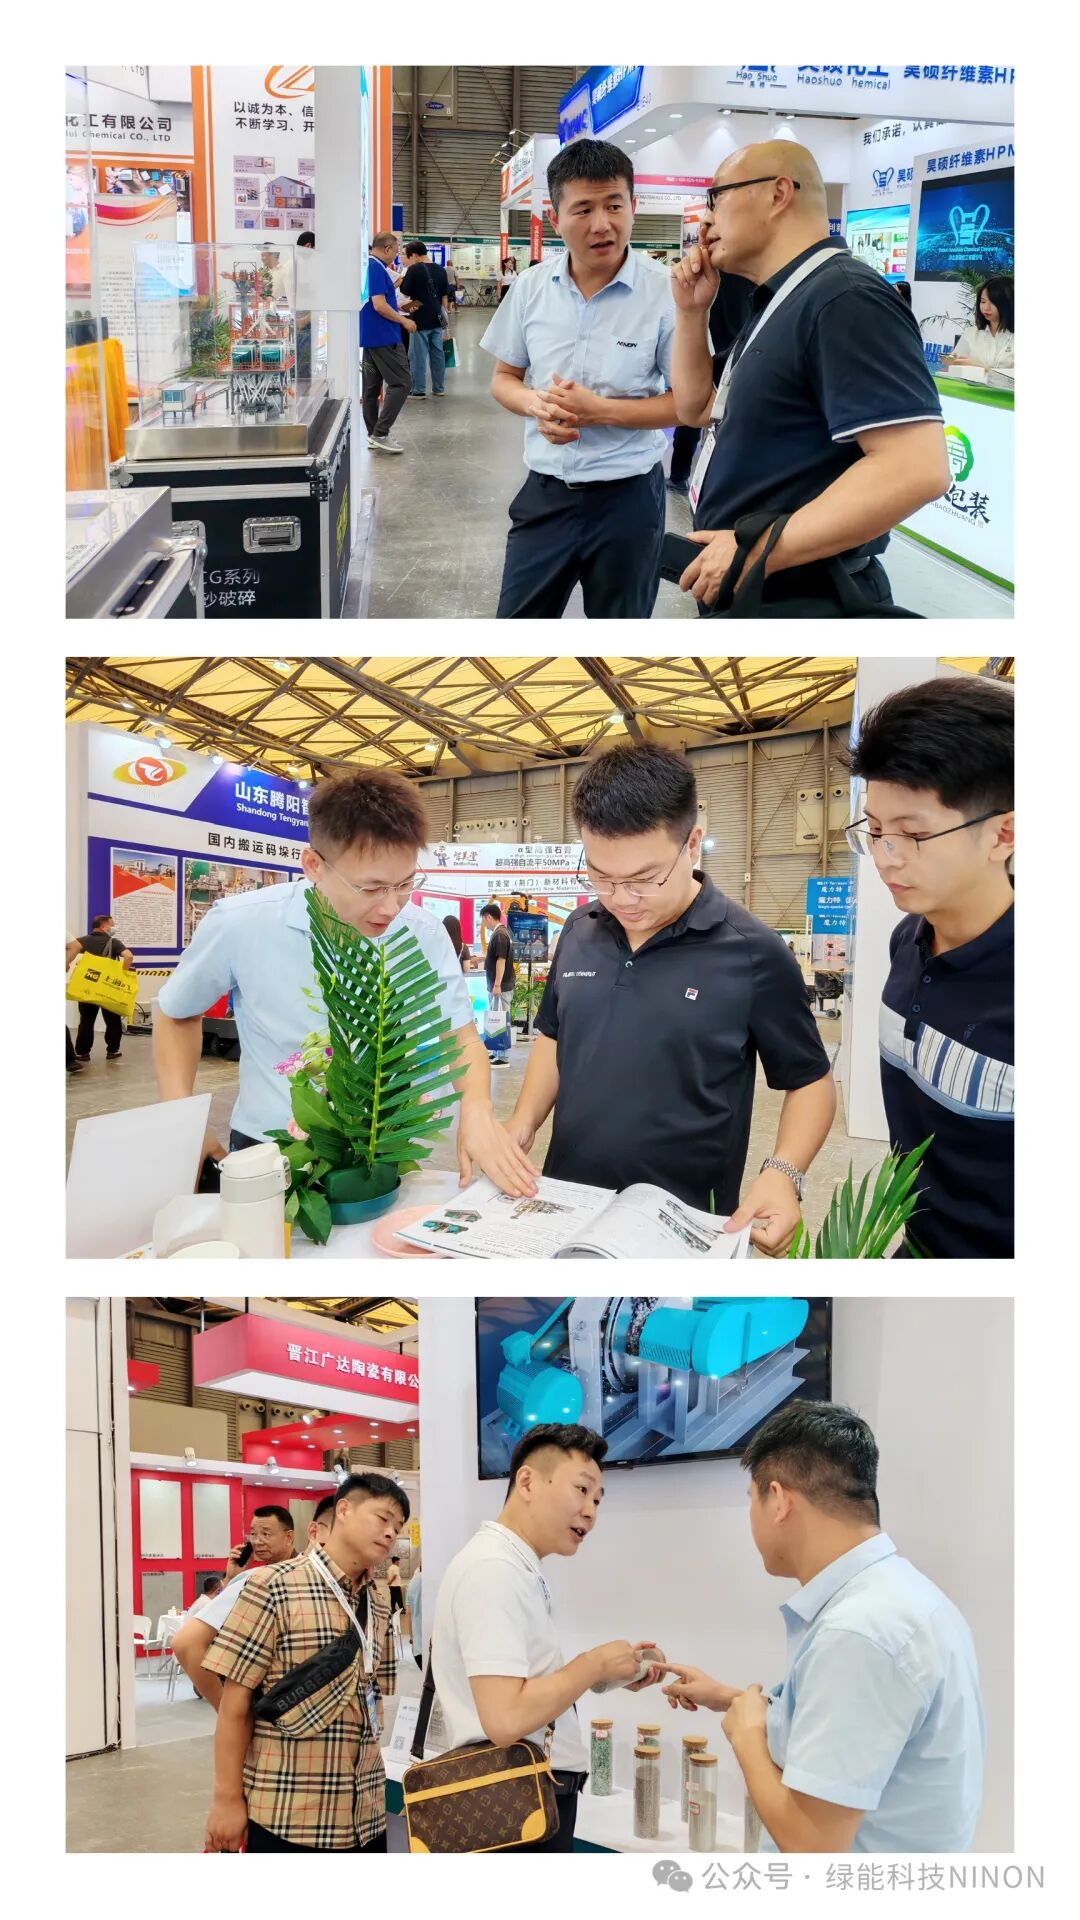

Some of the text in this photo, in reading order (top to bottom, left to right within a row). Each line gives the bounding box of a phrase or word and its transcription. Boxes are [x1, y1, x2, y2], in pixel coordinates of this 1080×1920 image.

[736, 71, 778, 82] Hao Shuo
[797, 74, 843, 86] Haoshuo
[153, 134, 171, 142] LTD
[236, 803, 277, 821] Shandong
[208, 832, 301, 860] 国内搬运码垛行
